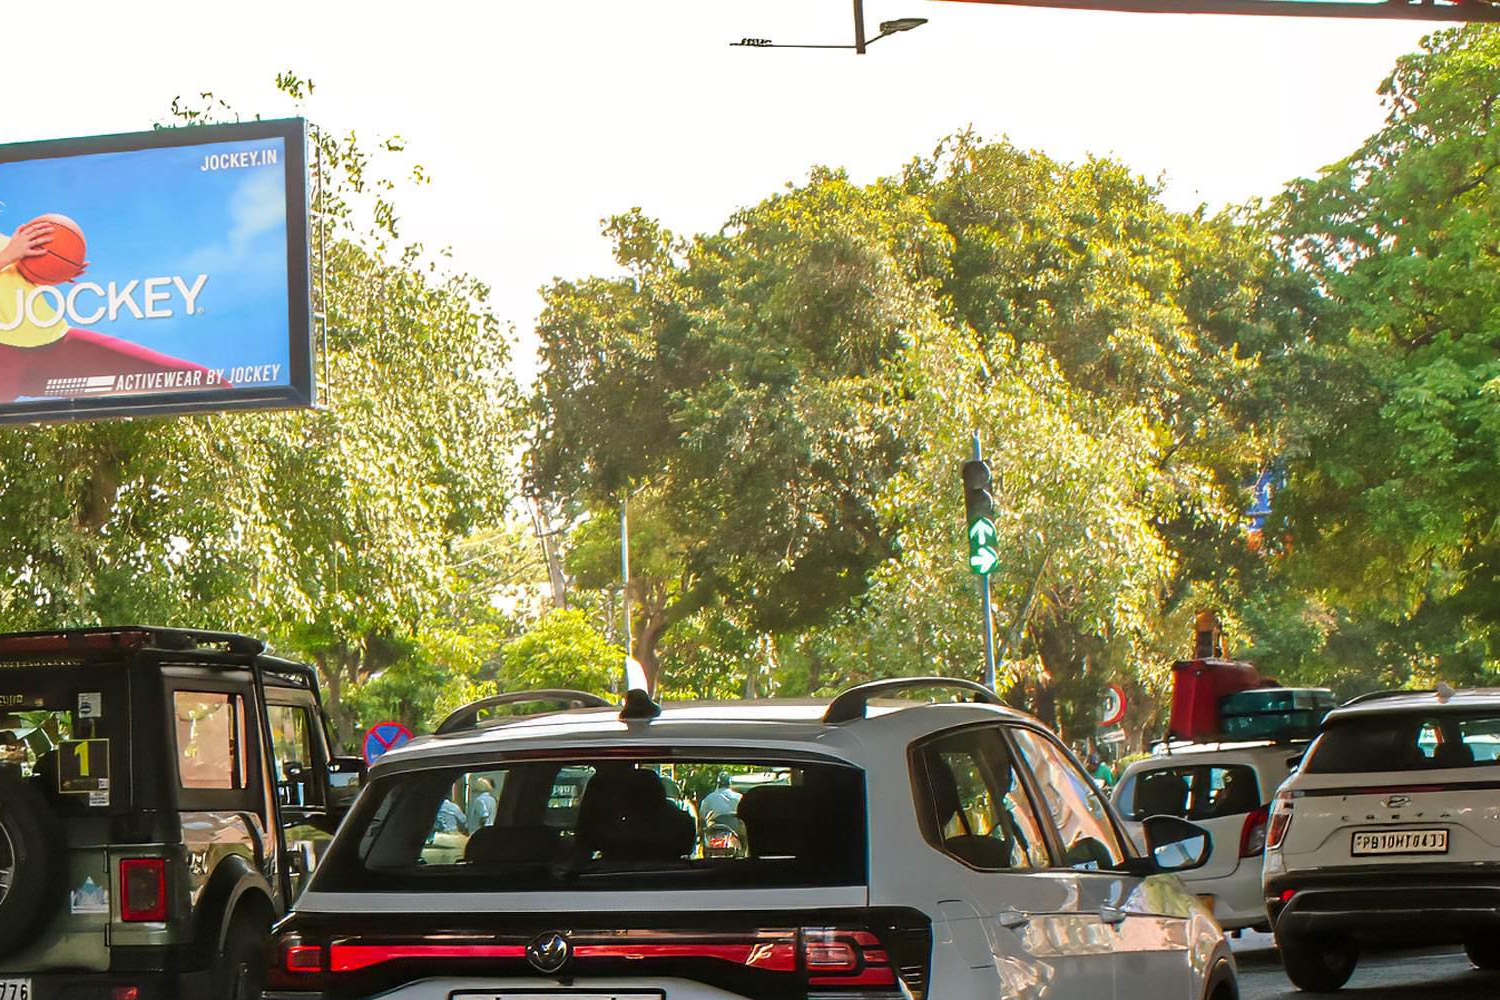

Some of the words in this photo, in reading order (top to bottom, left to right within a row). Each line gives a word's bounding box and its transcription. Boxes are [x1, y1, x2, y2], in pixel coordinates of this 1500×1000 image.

[200, 149, 277, 172] JOCKEY.IN
[115, 371, 201, 390] ACTIVEWEAR
[206, 368, 225, 385] BY
[228, 364, 281, 384] JOCKEY
[74, 741, 90, 777] 1
